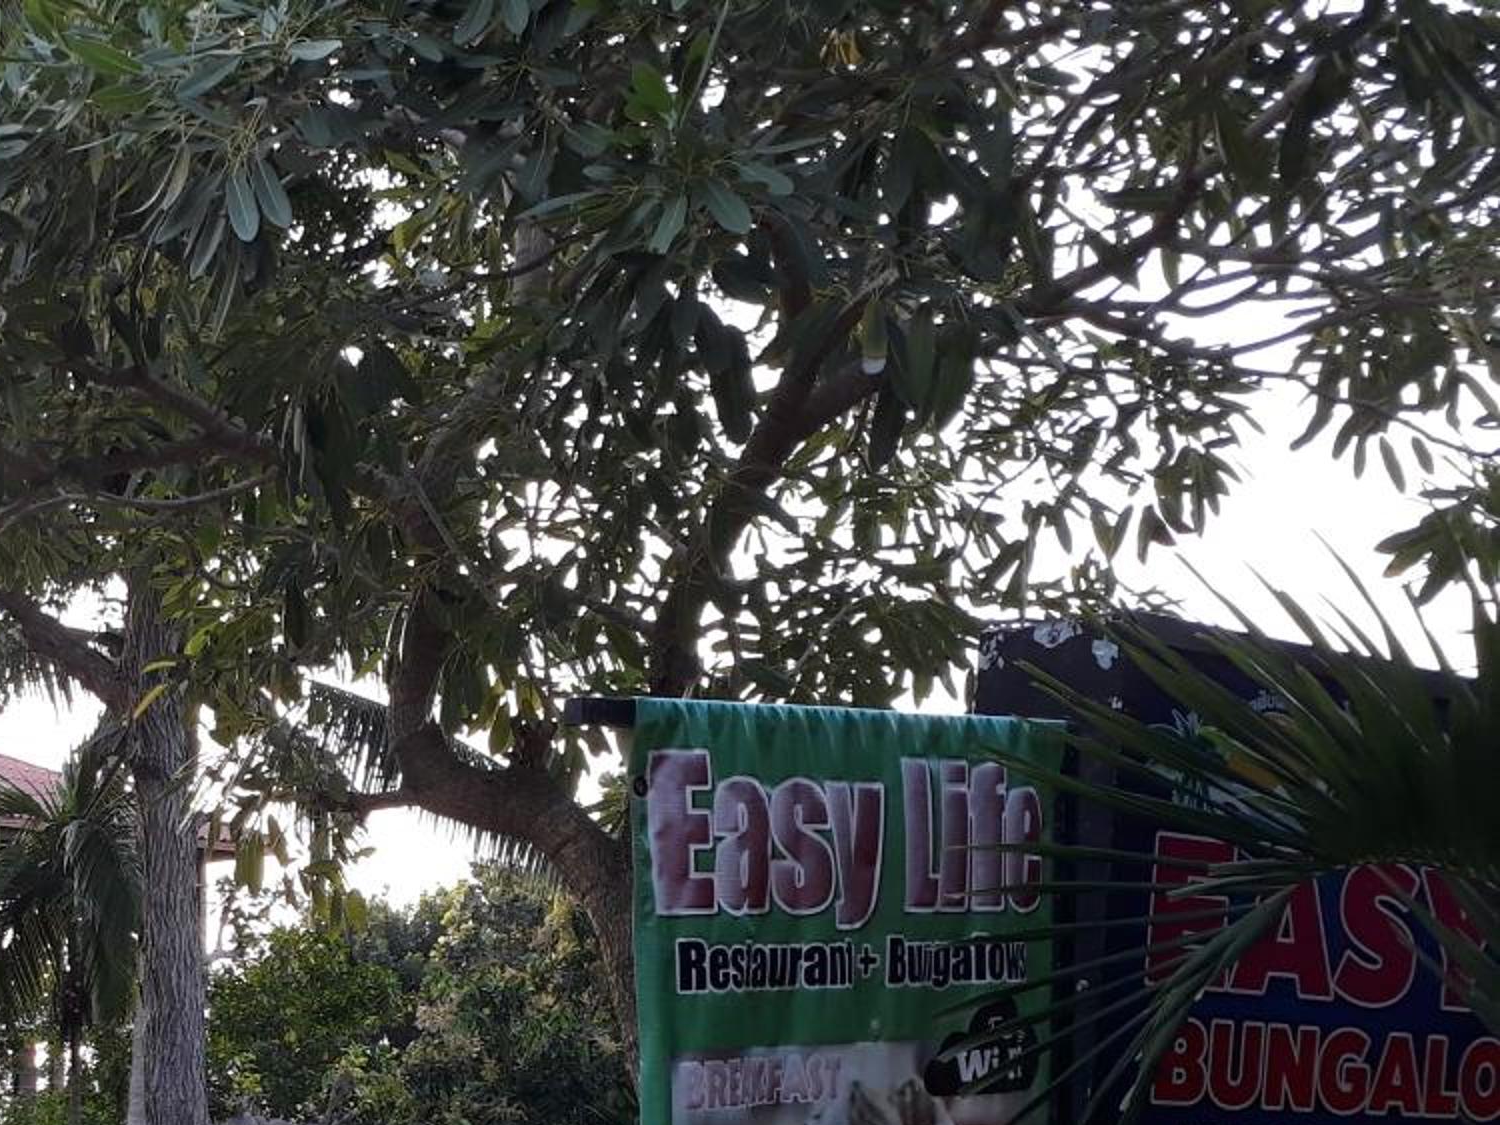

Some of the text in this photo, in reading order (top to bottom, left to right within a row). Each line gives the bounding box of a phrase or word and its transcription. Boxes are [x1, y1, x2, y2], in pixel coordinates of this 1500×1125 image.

[647, 748, 1044, 930] Easy Life
[675, 938, 854, 994] Restaurant
